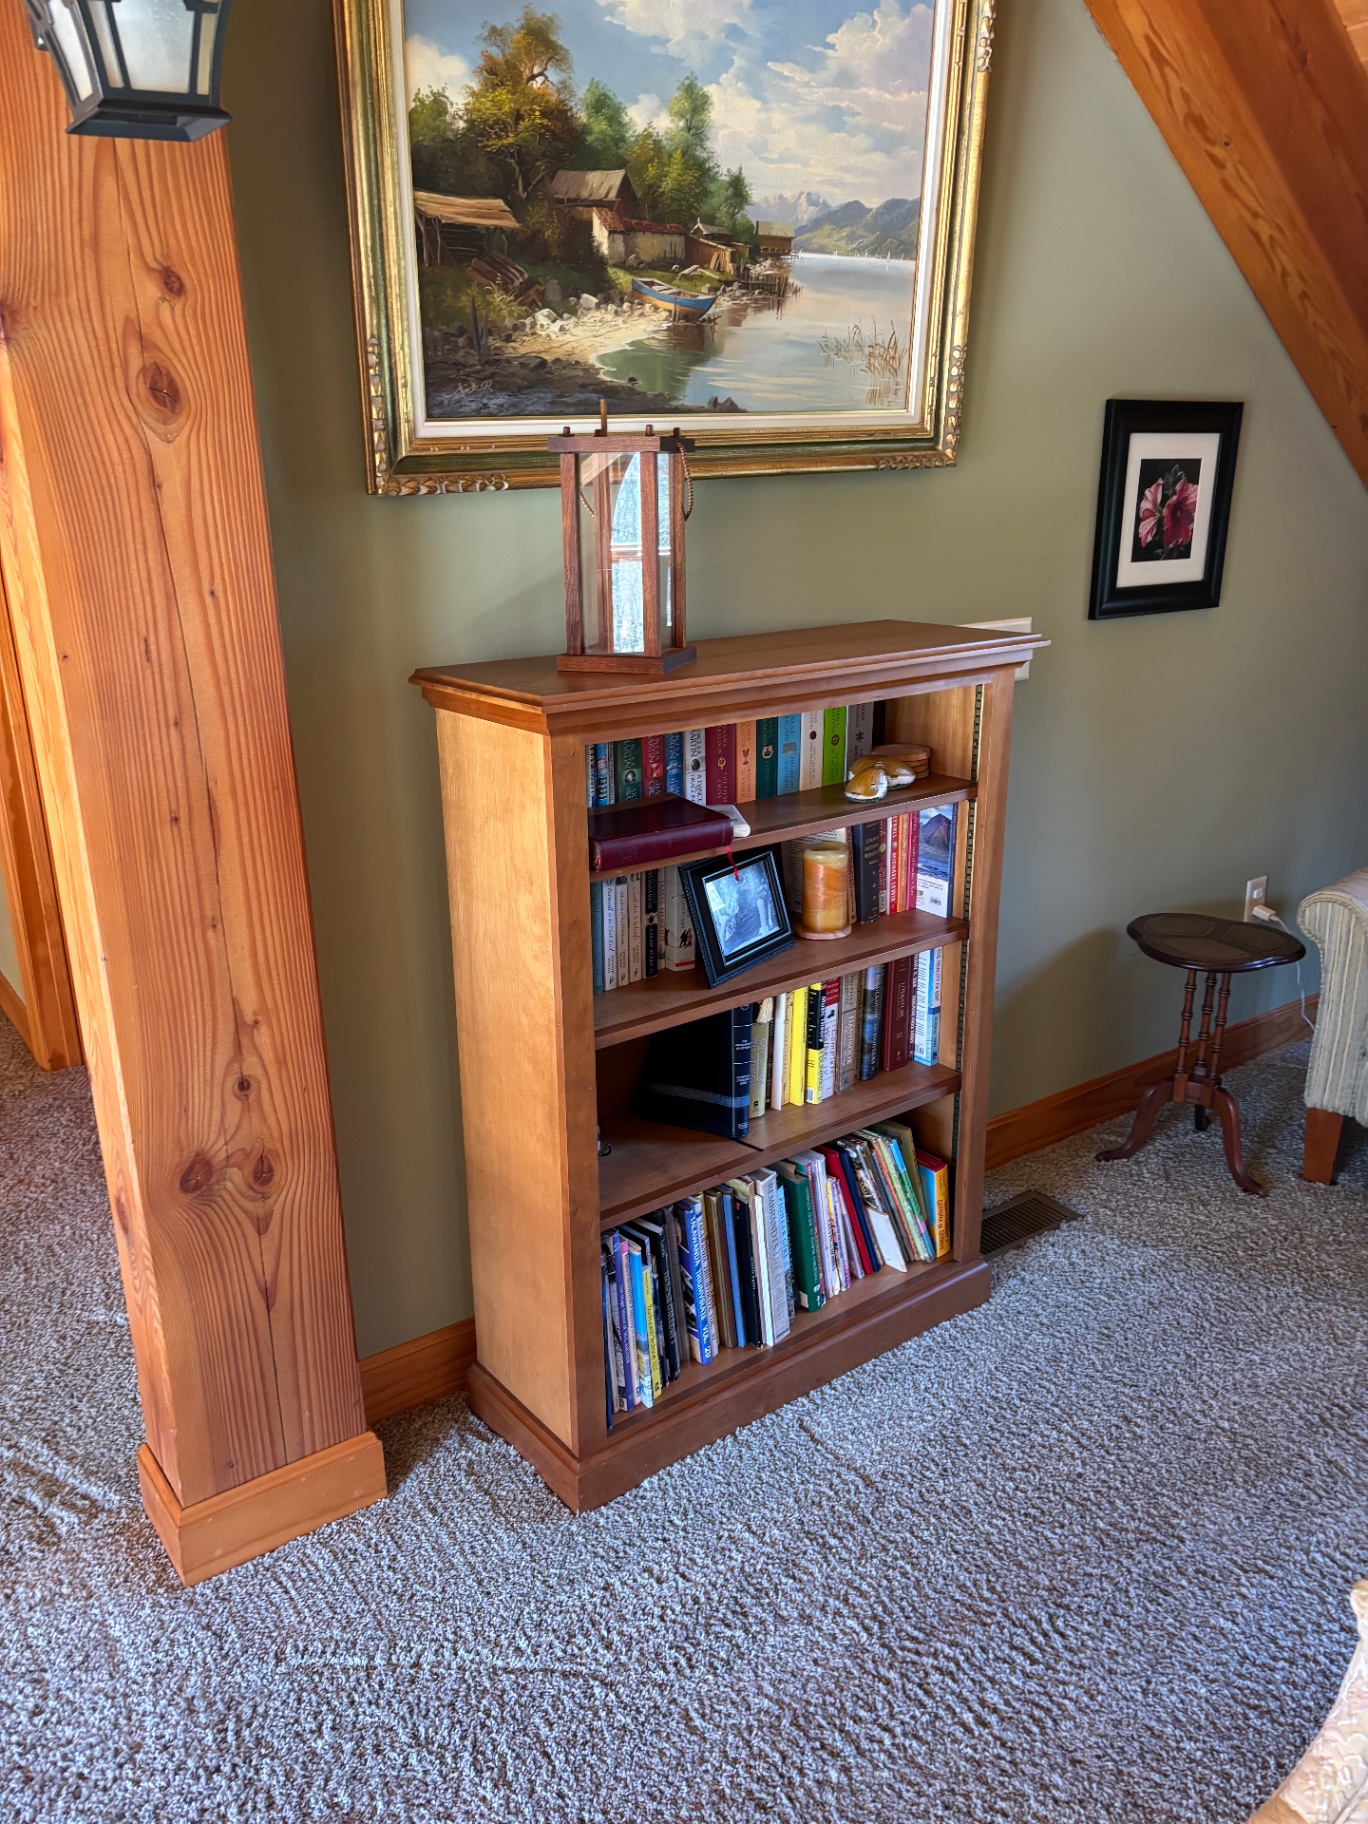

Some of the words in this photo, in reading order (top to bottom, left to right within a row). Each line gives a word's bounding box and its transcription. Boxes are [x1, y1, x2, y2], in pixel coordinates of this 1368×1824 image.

[846, 1015, 855, 1065] HANDBOOK
[768, 1184, 779, 1248] REMBRANDT'S
[778, 1197, 787, 1232] PIONEER
[690, 1216, 701, 1266] TALAWANDA
[698, 1218, 708, 1262] TALAWANDA
[772, 1251, 782, 1270] LIFE
[695, 1268, 707, 1320] TRIUMVIRATE
[702, 1264, 714, 1312] TRIUMVIRATE
[774, 1274, 782, 1286] OF
[776, 1288, 785, 1320] CHRIST
[702, 1324, 711, 1344] VOL.
